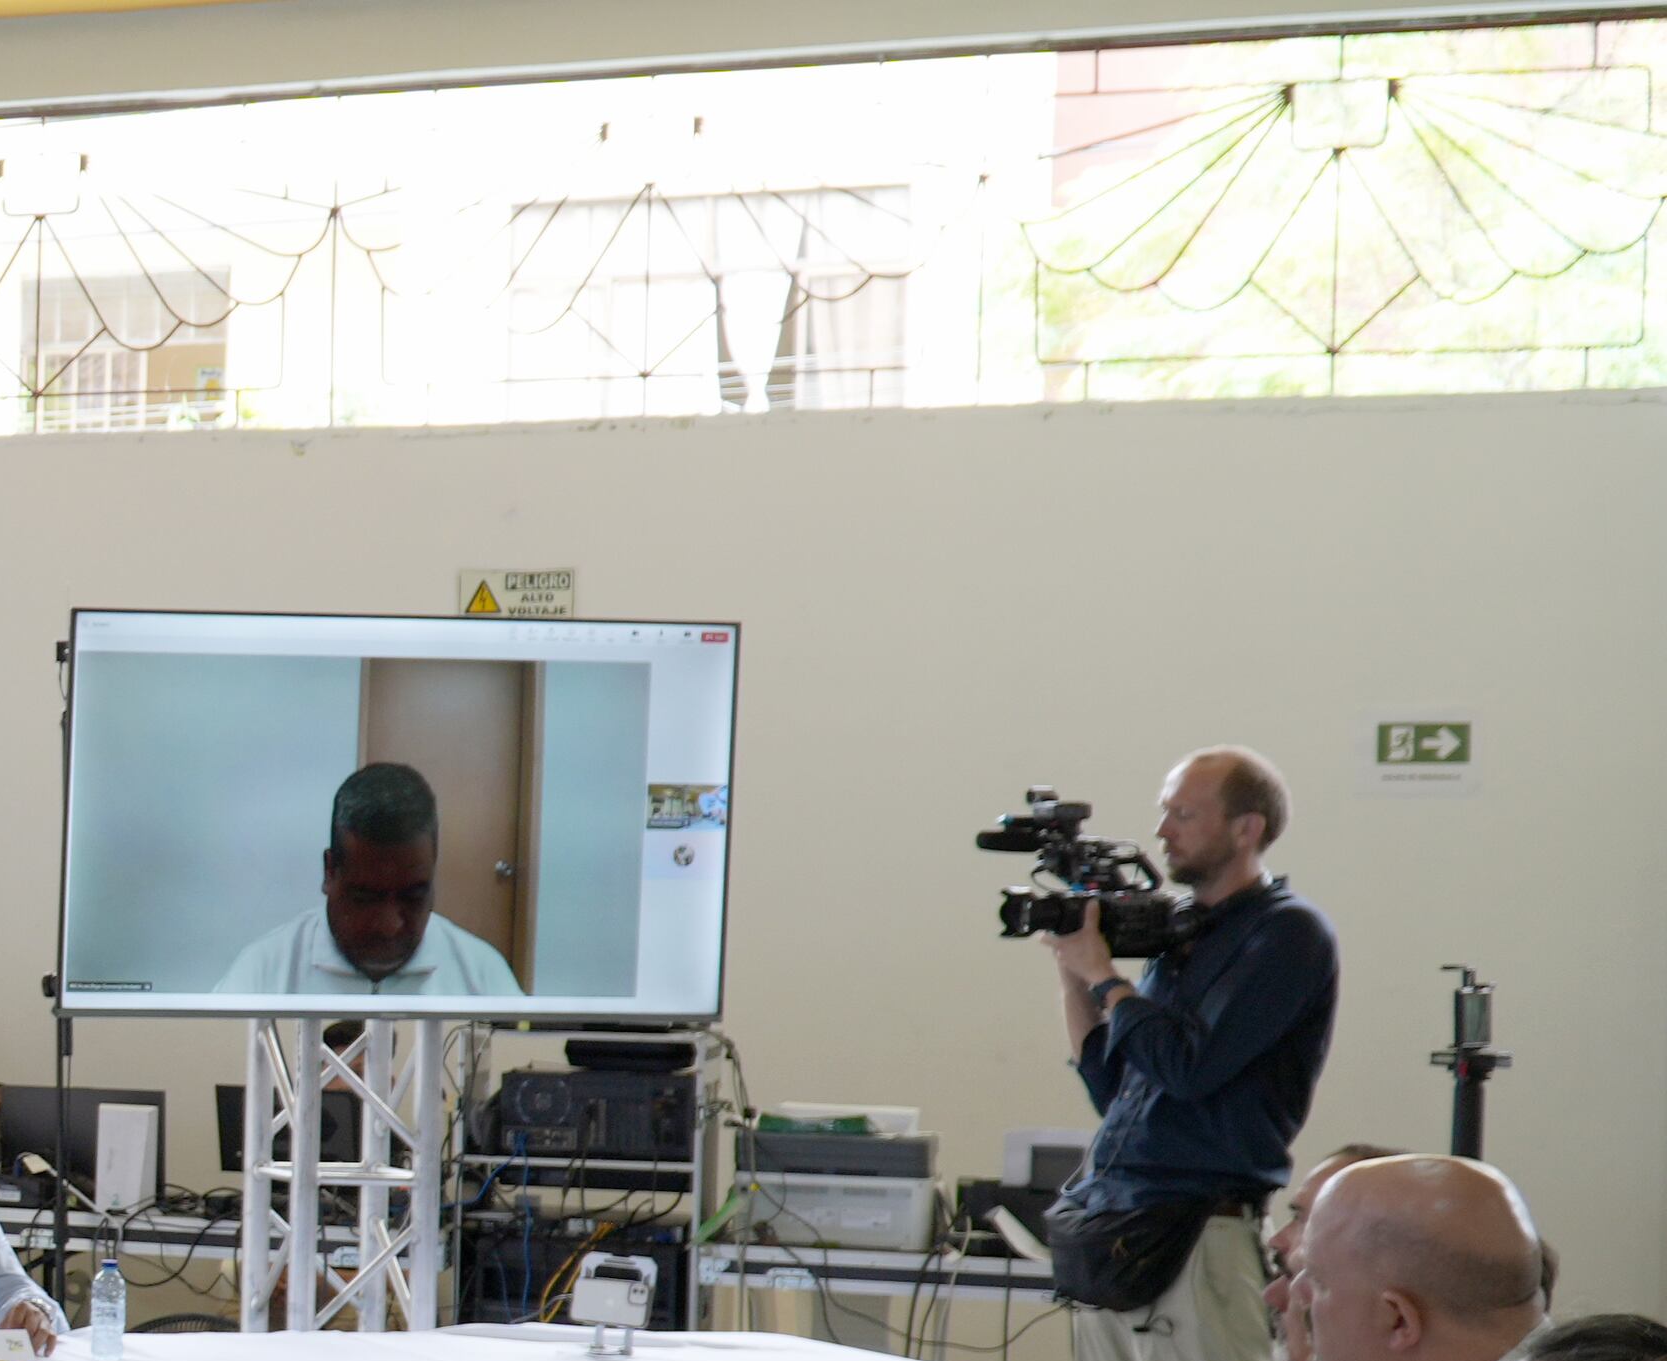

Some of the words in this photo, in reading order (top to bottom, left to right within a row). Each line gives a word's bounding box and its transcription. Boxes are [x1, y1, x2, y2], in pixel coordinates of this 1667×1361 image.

[506, 572, 570, 589] PELIGRO
[521, 592, 555, 602] ALTO
[508, 605, 567, 615] VOLTAJE
